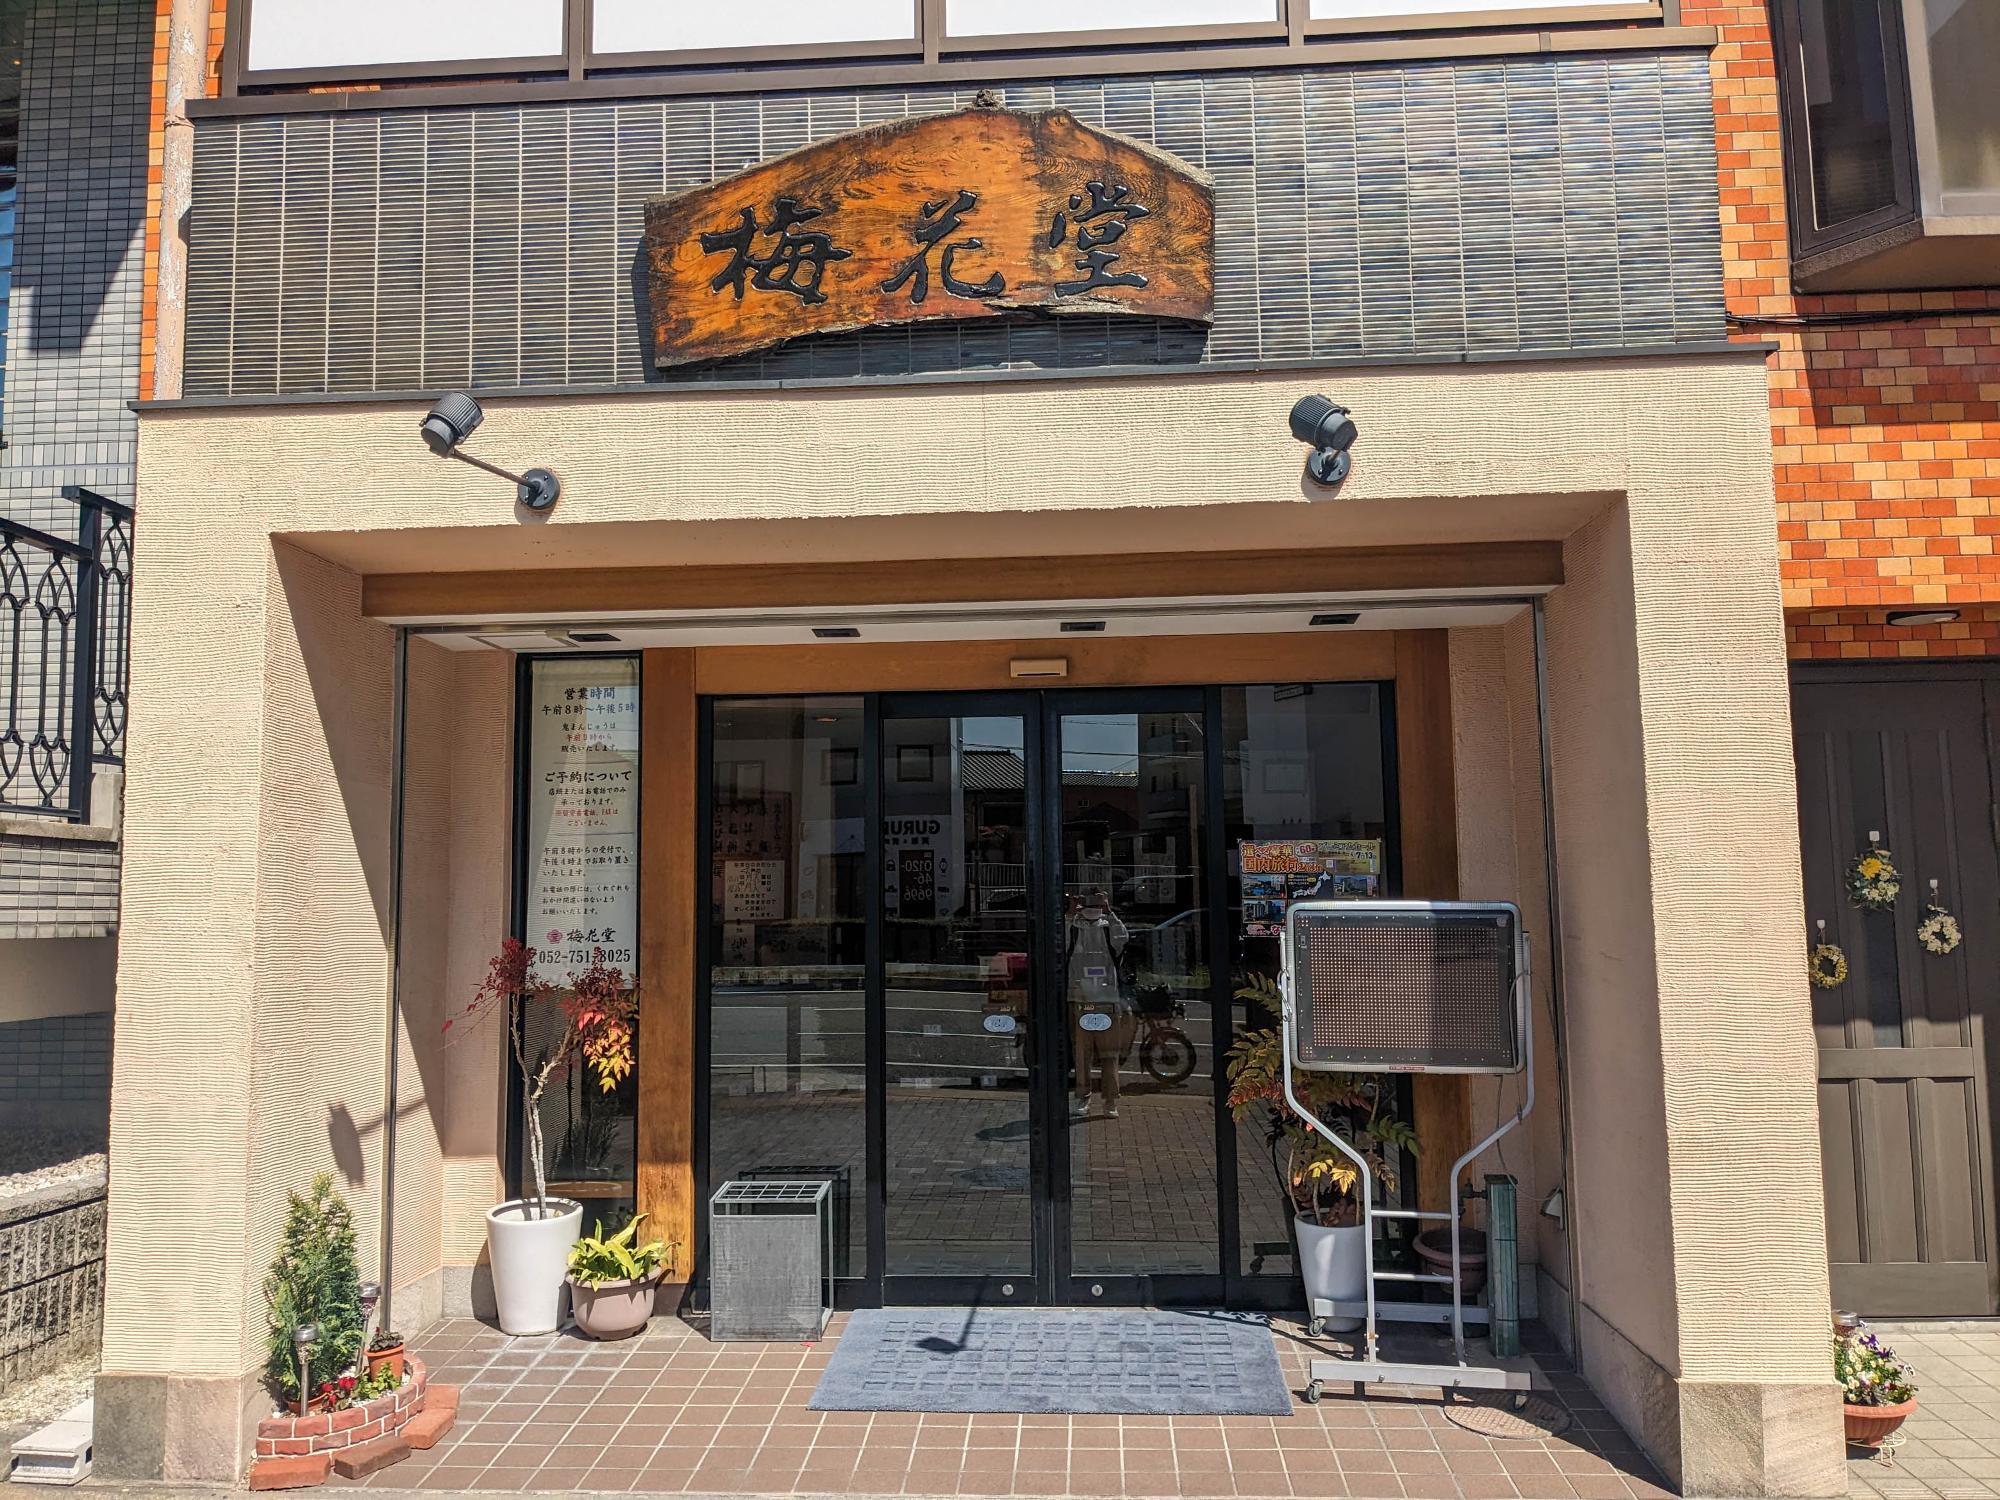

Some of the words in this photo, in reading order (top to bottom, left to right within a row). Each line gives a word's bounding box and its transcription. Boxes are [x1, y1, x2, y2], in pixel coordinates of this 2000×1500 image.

[701, 181, 1150, 305] 梅花堂
[564, 687, 615, 700] 営業時間
[561, 722, 616, 731] 鬼まんじゅうは
[561, 743, 618, 753] 販売いたします。
[544, 771, 632, 783] ご予約について
[543, 869, 586, 877] いたします。
[566, 927, 616, 943] 梅花堂
[538, 949, 631, 963] 052-7518025
